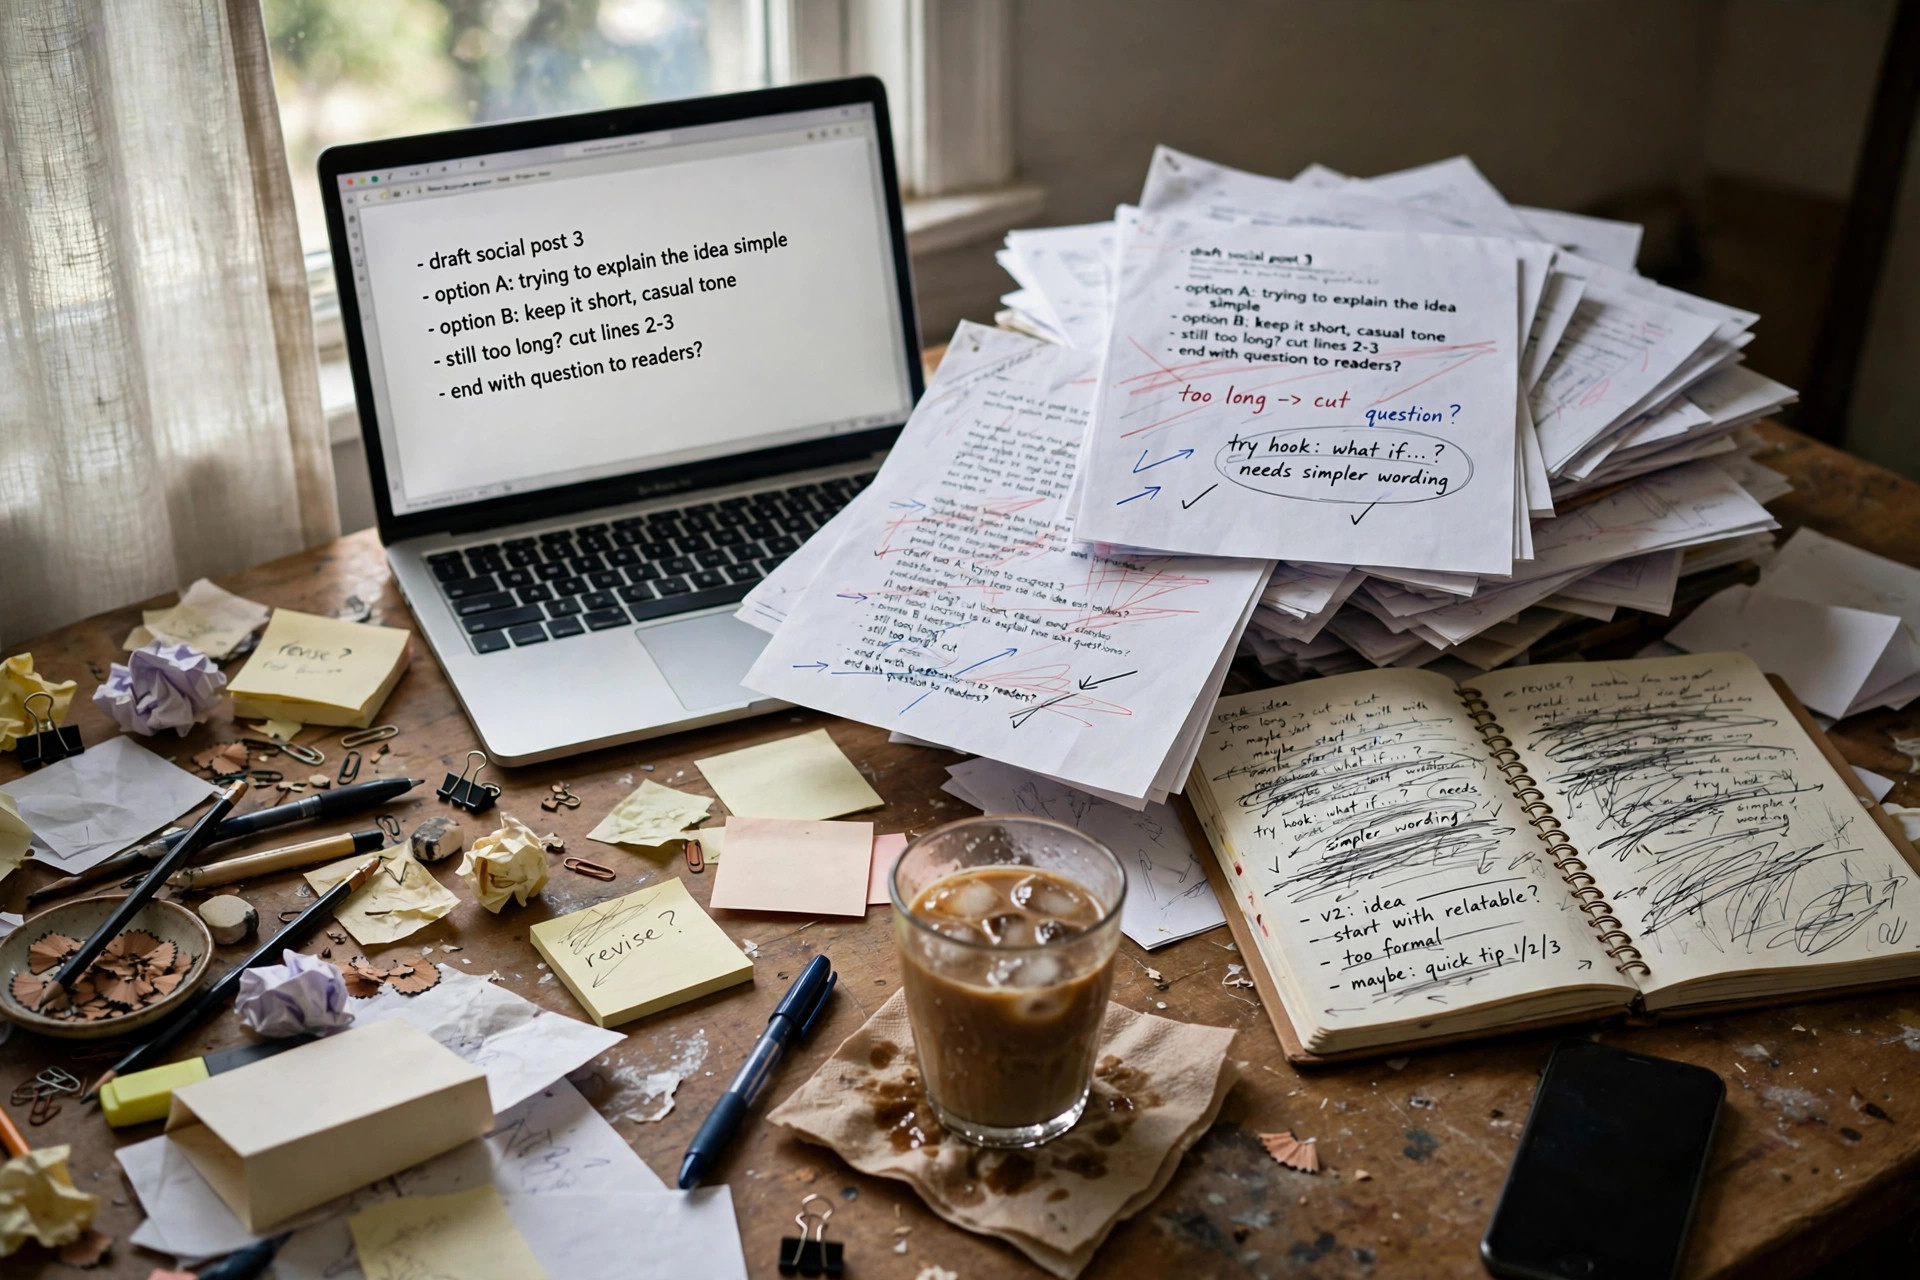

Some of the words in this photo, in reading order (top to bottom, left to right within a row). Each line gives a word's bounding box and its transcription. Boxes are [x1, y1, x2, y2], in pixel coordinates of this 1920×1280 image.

[429, 247, 473, 270] draft
[476, 237, 526, 263] social
[530, 233, 569, 258] post
[572, 230, 585, 248] 3
[434, 280, 491, 305] option
[495, 274, 514, 293] A:
[517, 266, 570, 291] trying
[573, 264, 592, 280] to
[596, 252, 657, 278] explain
[660, 247, 689, 266] the
[693, 241, 729, 261] idea
[733, 230, 788, 255] simple
[439, 313, 496, 338] option
[500, 307, 519, 325] B:
[524, 299, 566, 321] keep
[570, 296, 584, 314] it
[587, 288, 637, 311] short,
[641, 276, 694, 302] casual
[698, 274, 737, 293] tone
[1185, 284, 1233, 296] option
[1262, 288, 1307, 304] trying
[1312, 292, 1328, 303] to
[1332, 294, 1388, 309] explain
[1393, 297, 1419, 311] the
[1424, 299, 1457, 313] idea
[1209, 297, 1261, 313] simple
[445, 345, 477, 367] still
[481, 343, 511, 361] too
[515, 331, 563, 355] long?
[569, 327, 598, 346] cut
[600, 321, 640, 341] lines
[644, 313, 675, 334] 2-3
[1181, 329, 1208, 341] still
[1214, 332, 1238, 343] too
[1243, 331, 1282, 349] long?
[1285, 338, 1308, 349] cut
[1313, 337, 1347, 352] lines
[1352, 340, 1379, 355] 2-3
[1182, 314, 1228, 326] option
[1233, 314, 1249, 327] B:
[1255, 316, 1290, 333] keep
[1294, 320, 1304, 331] it
[1309, 321, 1351, 337] short,
[1356, 326, 1405, 341] casual
[1410, 329, 1446, 343] tone
[450, 377, 484, 399] end
[487, 370, 526, 393] with
[530, 359, 605, 390] question
[608, 356, 627, 372] to
[631, 340, 703, 369] readers?
[1178, 345, 1206, 357] end
[1208, 347, 1239, 359] with
[1243, 351, 1308, 367] question
[1313, 355, 1329, 367] to
[1334, 357, 1402, 374] readers?
[1178, 384, 1212, 402] too
[1225, 385, 1266, 414] long
[1314, 390, 1351, 409] cut
[1228, 433, 1259, 460] try
[1333, 439, 1380, 457] what
[1239, 461, 1292, 477] needs
[1302, 465, 1369, 487] simpler
[1378, 468, 1449, 495] wording
[1229, 723, 1249, 734] too
[1260, 717, 1286, 728] long
[1313, 703, 1333, 715] cut
[1439, 782, 1478, 795] needs
[1253, 825, 1276, 840] try
[1327, 803, 1358, 819] what
[1326, 829, 1381, 850] simpler
[1395, 811, 1459, 833] wording
[1334, 919, 1381, 943] start
[1392, 906, 1434, 929] with
[1445, 884, 1540, 918] relatable?
[1362, 895, 1406, 914] idea
[584, 909, 683, 968] revise?
[1342, 949, 1373, 966] too
[1382, 926, 1443, 960] formal
[1352, 966, 1416, 993] maybe:
[1425, 952, 1473, 982] quick
[1478, 947, 1504, 967] tip
[1513, 933, 1561, 963] 1/2/3
